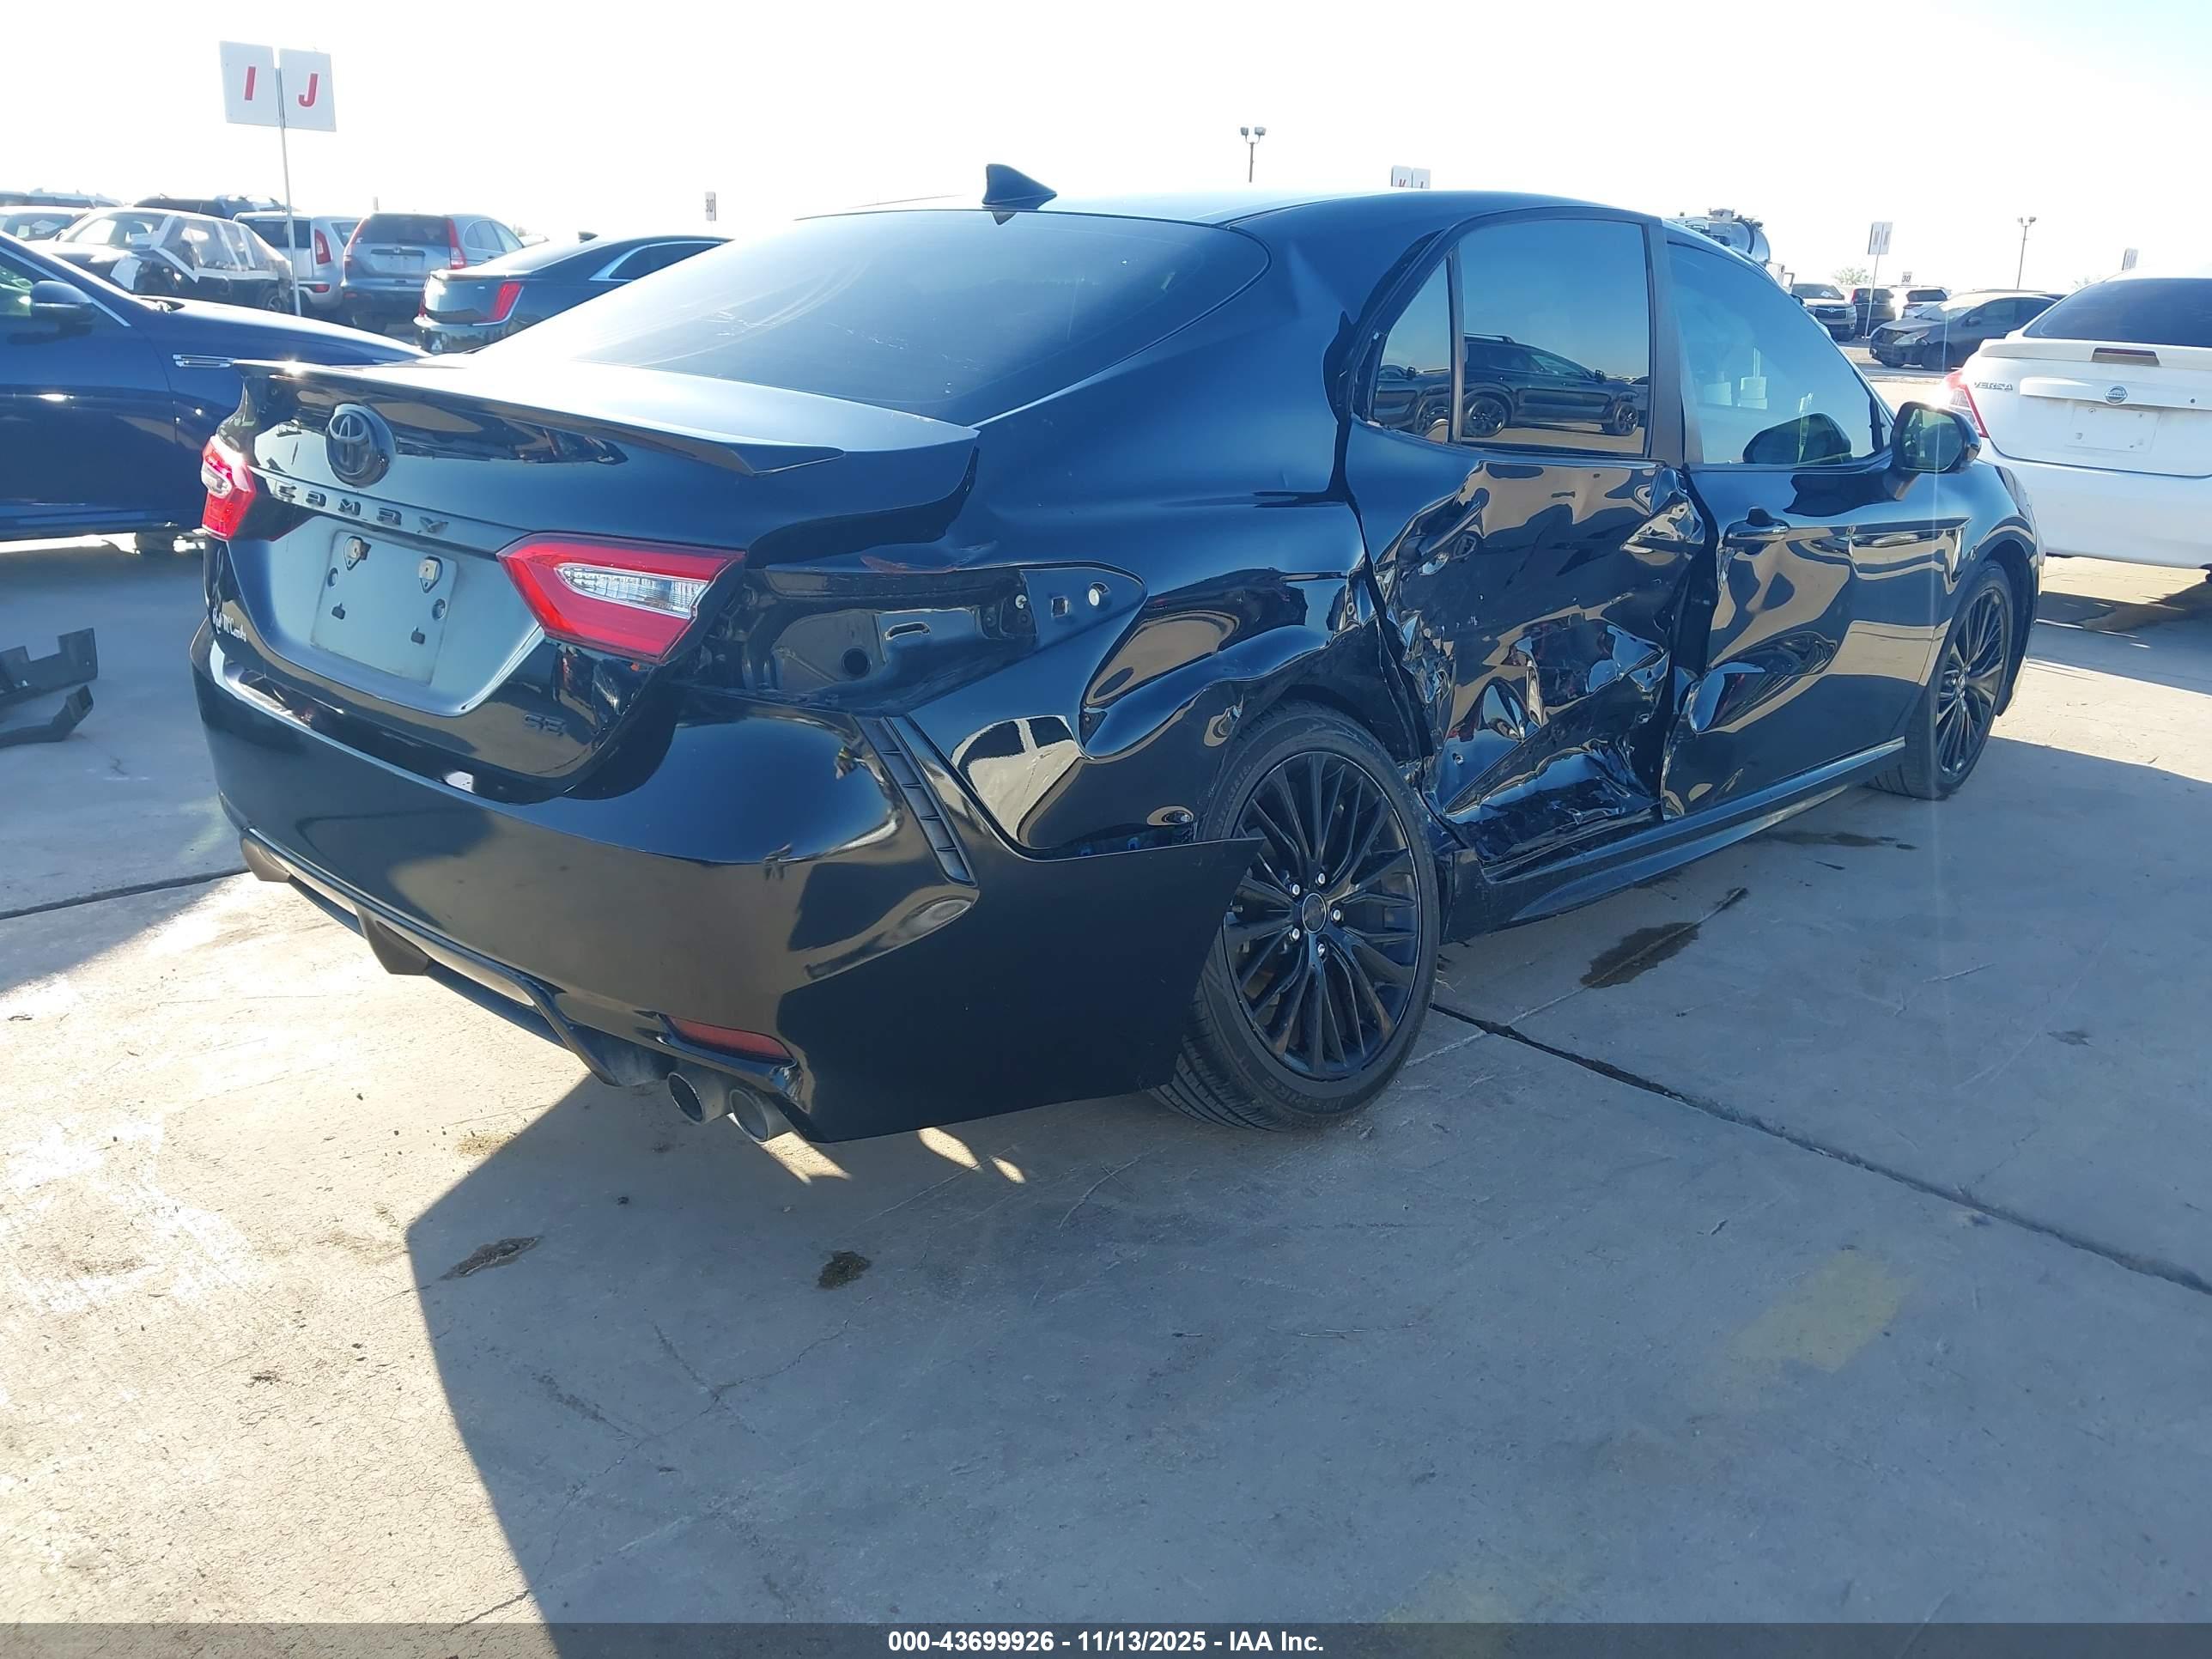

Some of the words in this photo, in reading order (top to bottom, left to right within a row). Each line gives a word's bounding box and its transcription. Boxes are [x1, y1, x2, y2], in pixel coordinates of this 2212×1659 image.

[244, 66, 257, 101] I
[298, 73, 319, 107] J
[1973, 381, 2013, 392] VERSA
[278, 483, 449, 534] CAMRY
